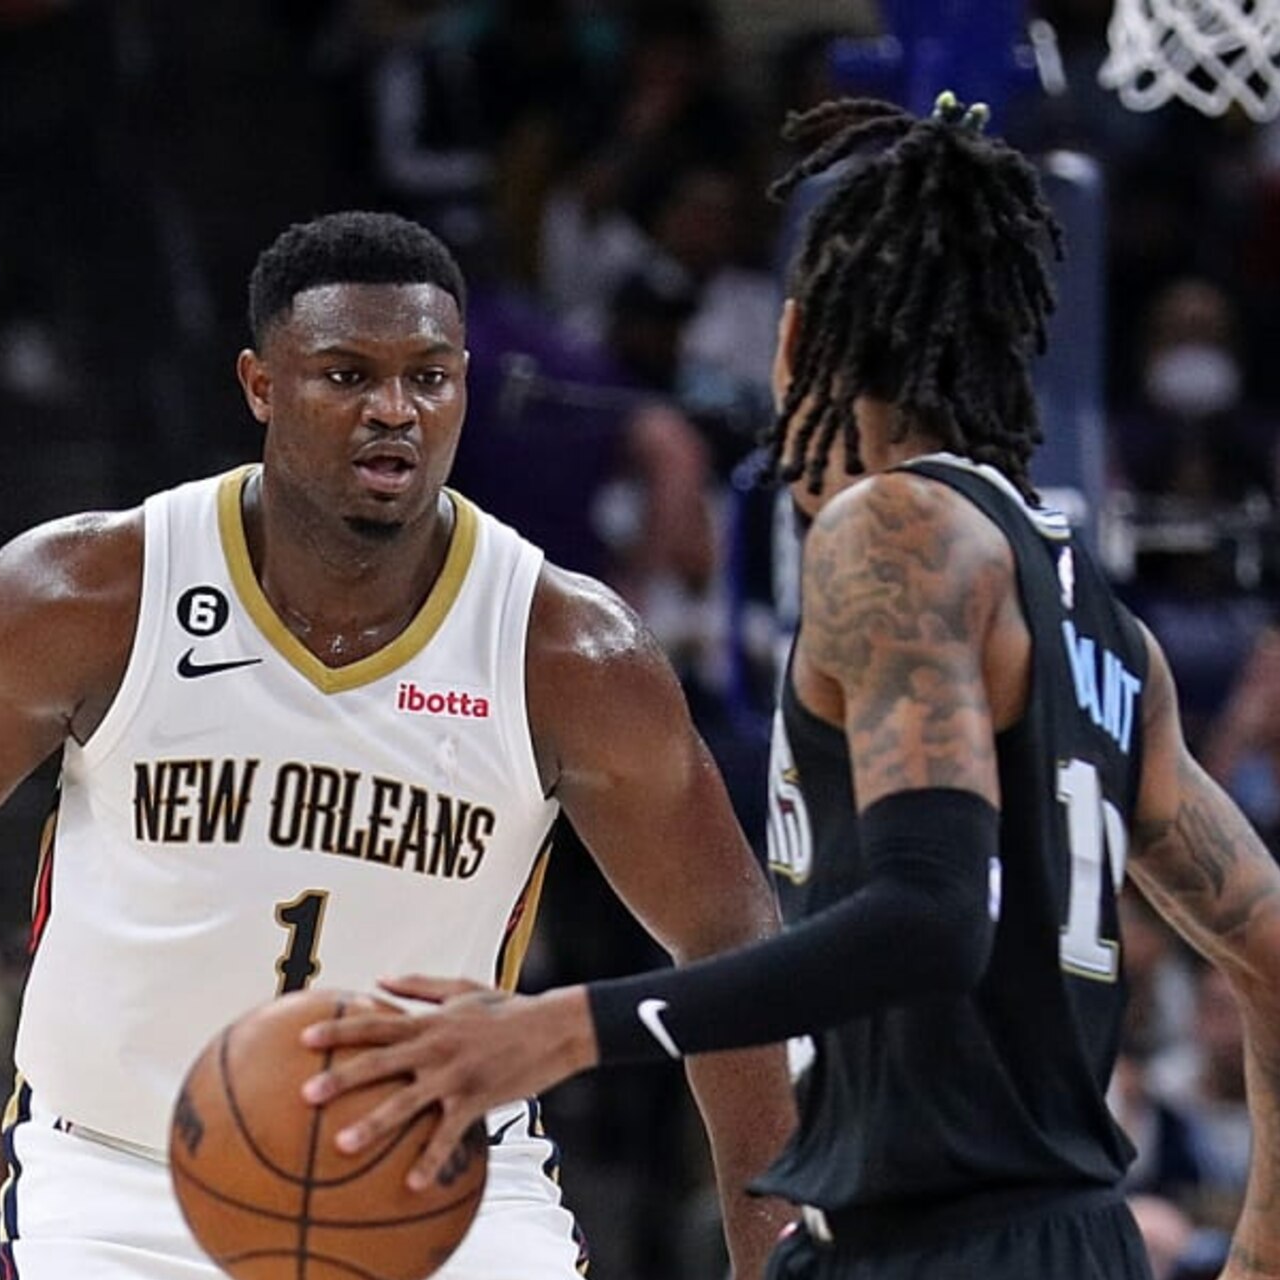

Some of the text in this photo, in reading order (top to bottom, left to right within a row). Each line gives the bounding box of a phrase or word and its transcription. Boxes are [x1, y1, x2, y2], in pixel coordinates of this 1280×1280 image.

[189, 594, 218, 630] 6
[397, 683, 489, 718] ibotta
[133, 758, 497, 880] NEW ORLEANS
[274, 888, 330, 1000] 1
